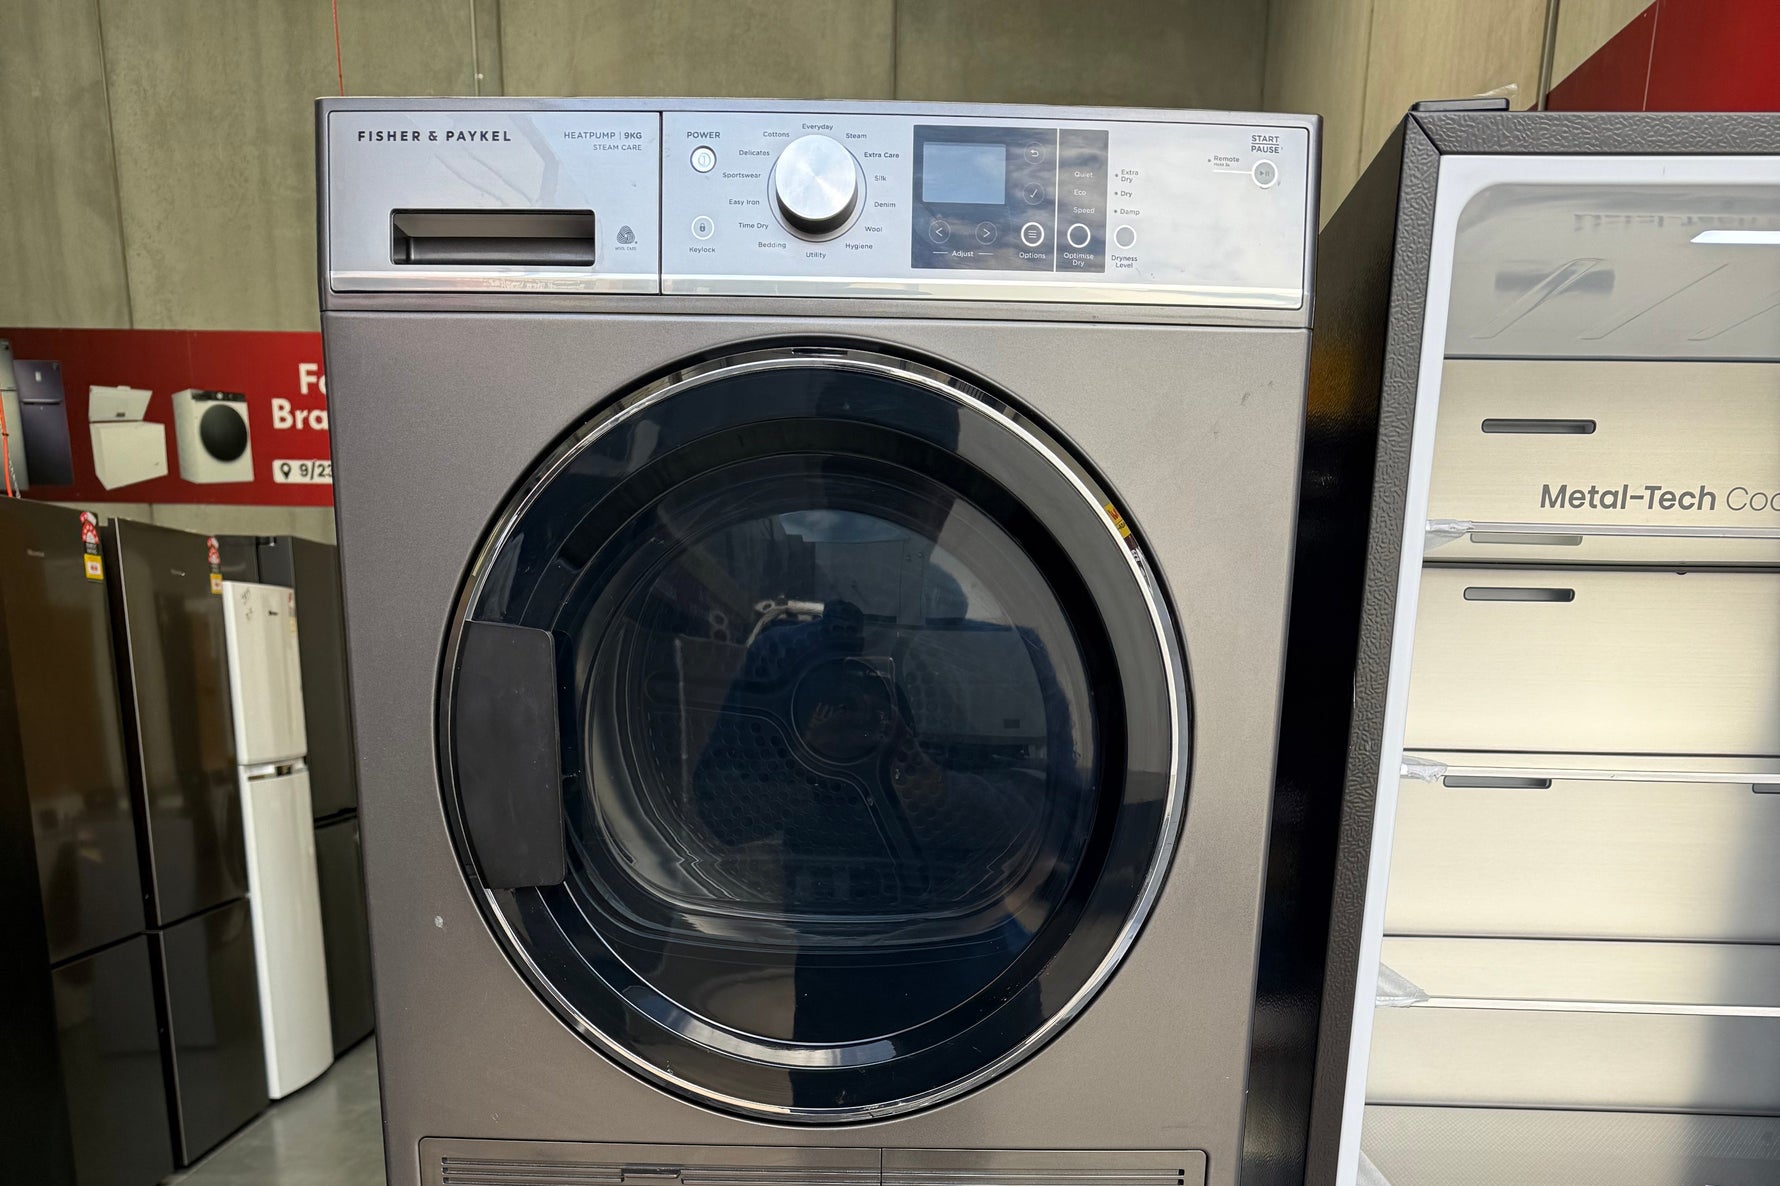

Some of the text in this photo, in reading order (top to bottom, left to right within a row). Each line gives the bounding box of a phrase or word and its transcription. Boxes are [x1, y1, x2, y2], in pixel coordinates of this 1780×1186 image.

[801, 123, 834, 131] Everyday
[357, 131, 511, 142] FISHER & PAYKEL
[563, 131, 643, 139] HEATPUMP 9KG
[686, 131, 721, 139] POWER
[845, 132, 867, 140] Steam
[1251, 134, 1280, 143] START
[1250, 145, 1280, 154] PAUSE
[1213, 155, 1240, 163] Remote
[722, 172, 761, 180] Sportswear
[1120, 190, 1133, 198] Dry
[728, 199, 744, 207] Easy
[1073, 206, 1095, 215] Speed
[1120, 208, 1140, 216] Damp
[758, 241, 787, 249] Bedding
[845, 242, 873, 251] Hygiene
[689, 246, 716, 254] Keylock
[952, 249, 974, 259] Adjust
[805, 251, 827, 259] Utility
[1019, 251, 1046, 260] Options
[1063, 252, 1095, 260] Optimise
[271, 397, 329, 430] Bra
[1540, 483, 1717, 511] Metal-Tech
